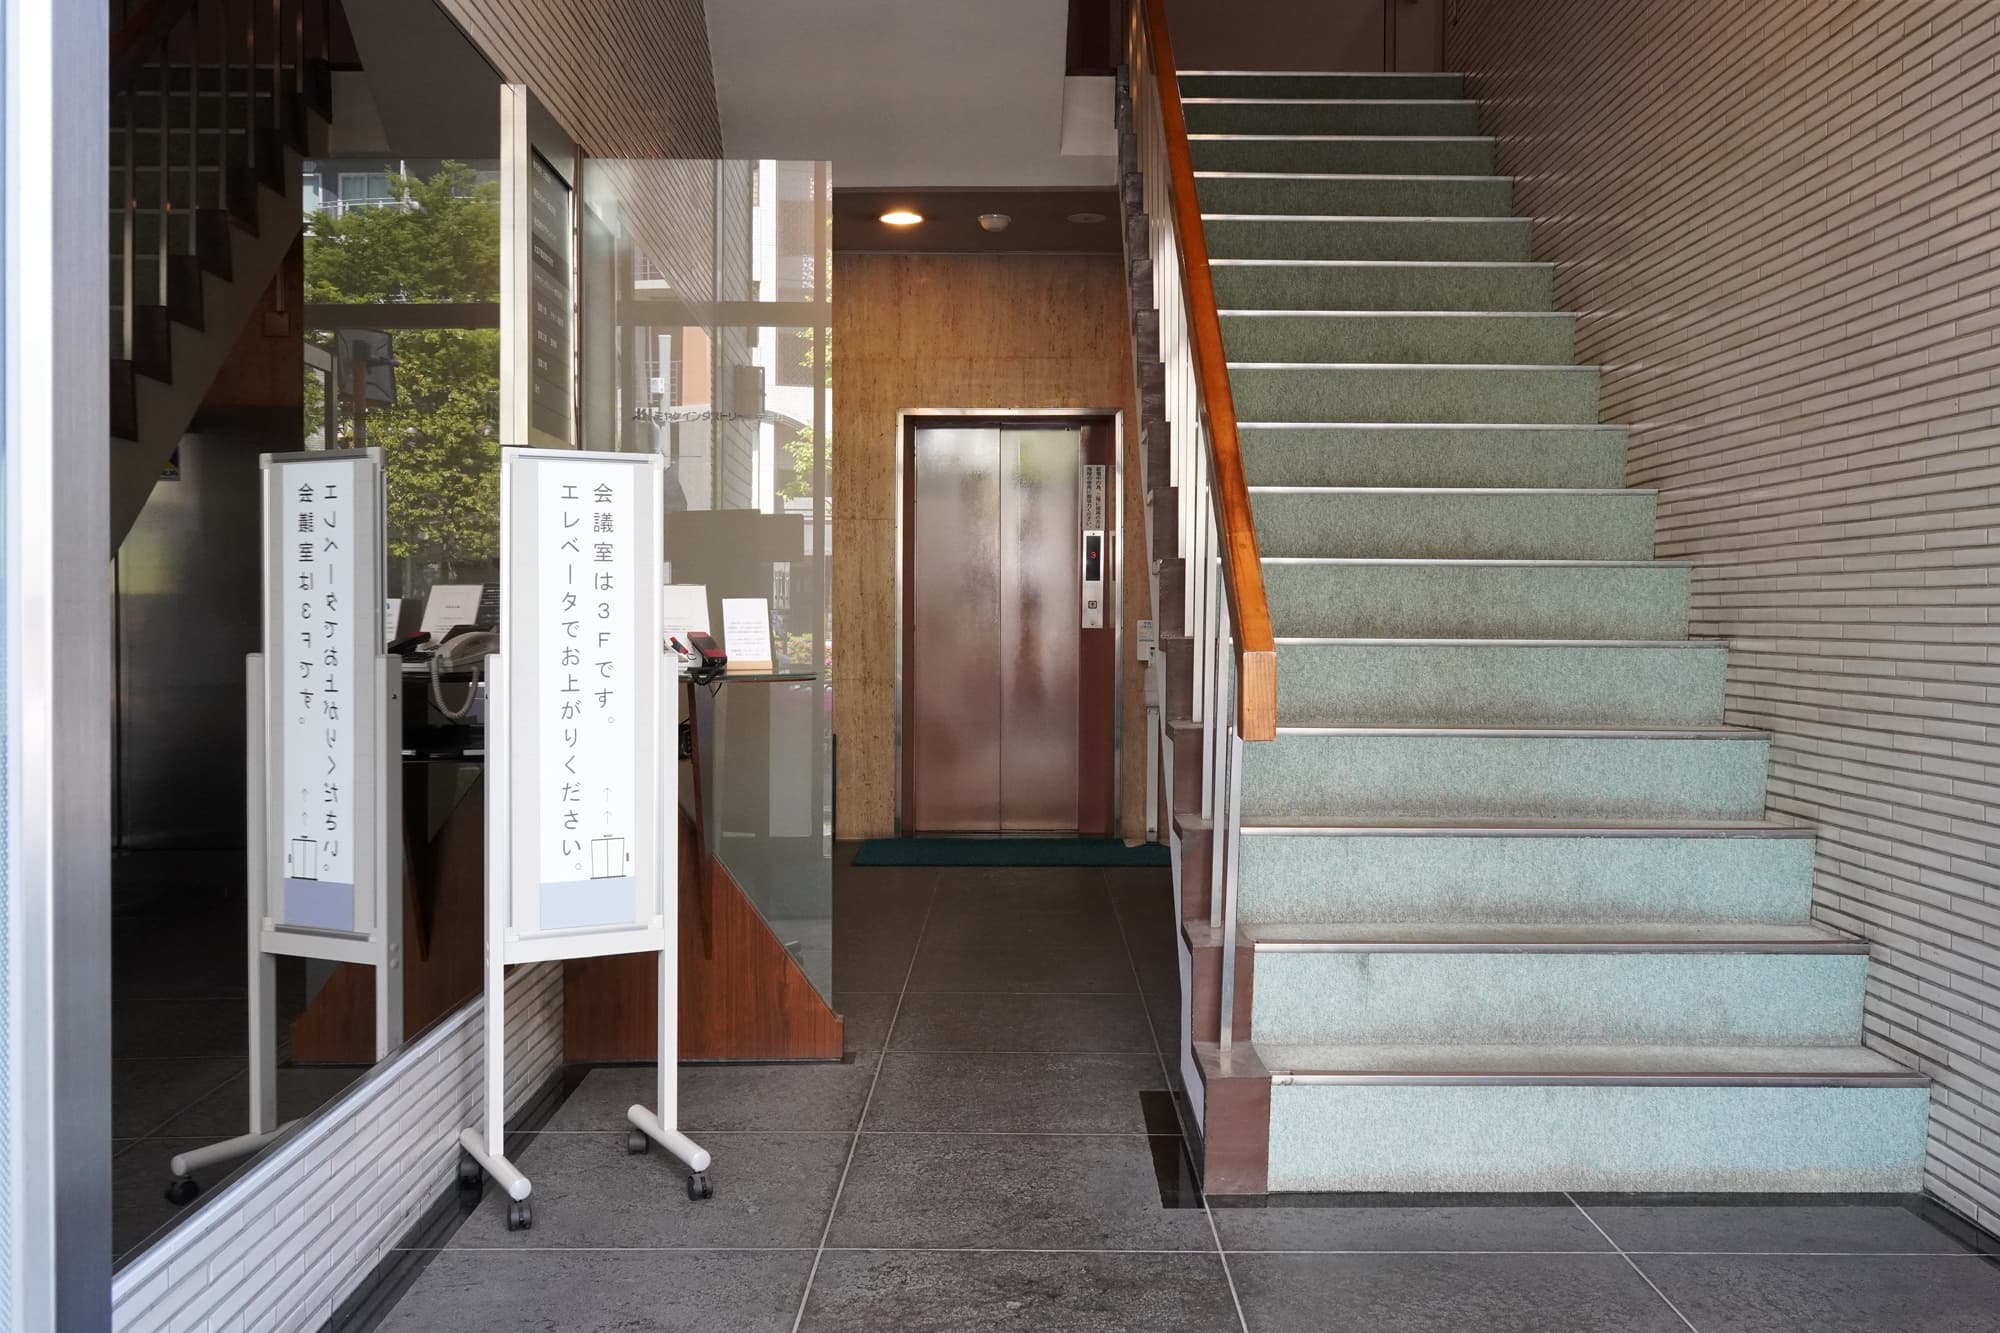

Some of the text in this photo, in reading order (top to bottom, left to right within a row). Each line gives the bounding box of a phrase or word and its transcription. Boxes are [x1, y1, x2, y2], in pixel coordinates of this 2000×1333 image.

[560, 484, 582, 871] エレベータでお上がりください。
[592, 483, 615, 724] 会議室は3Fです。
